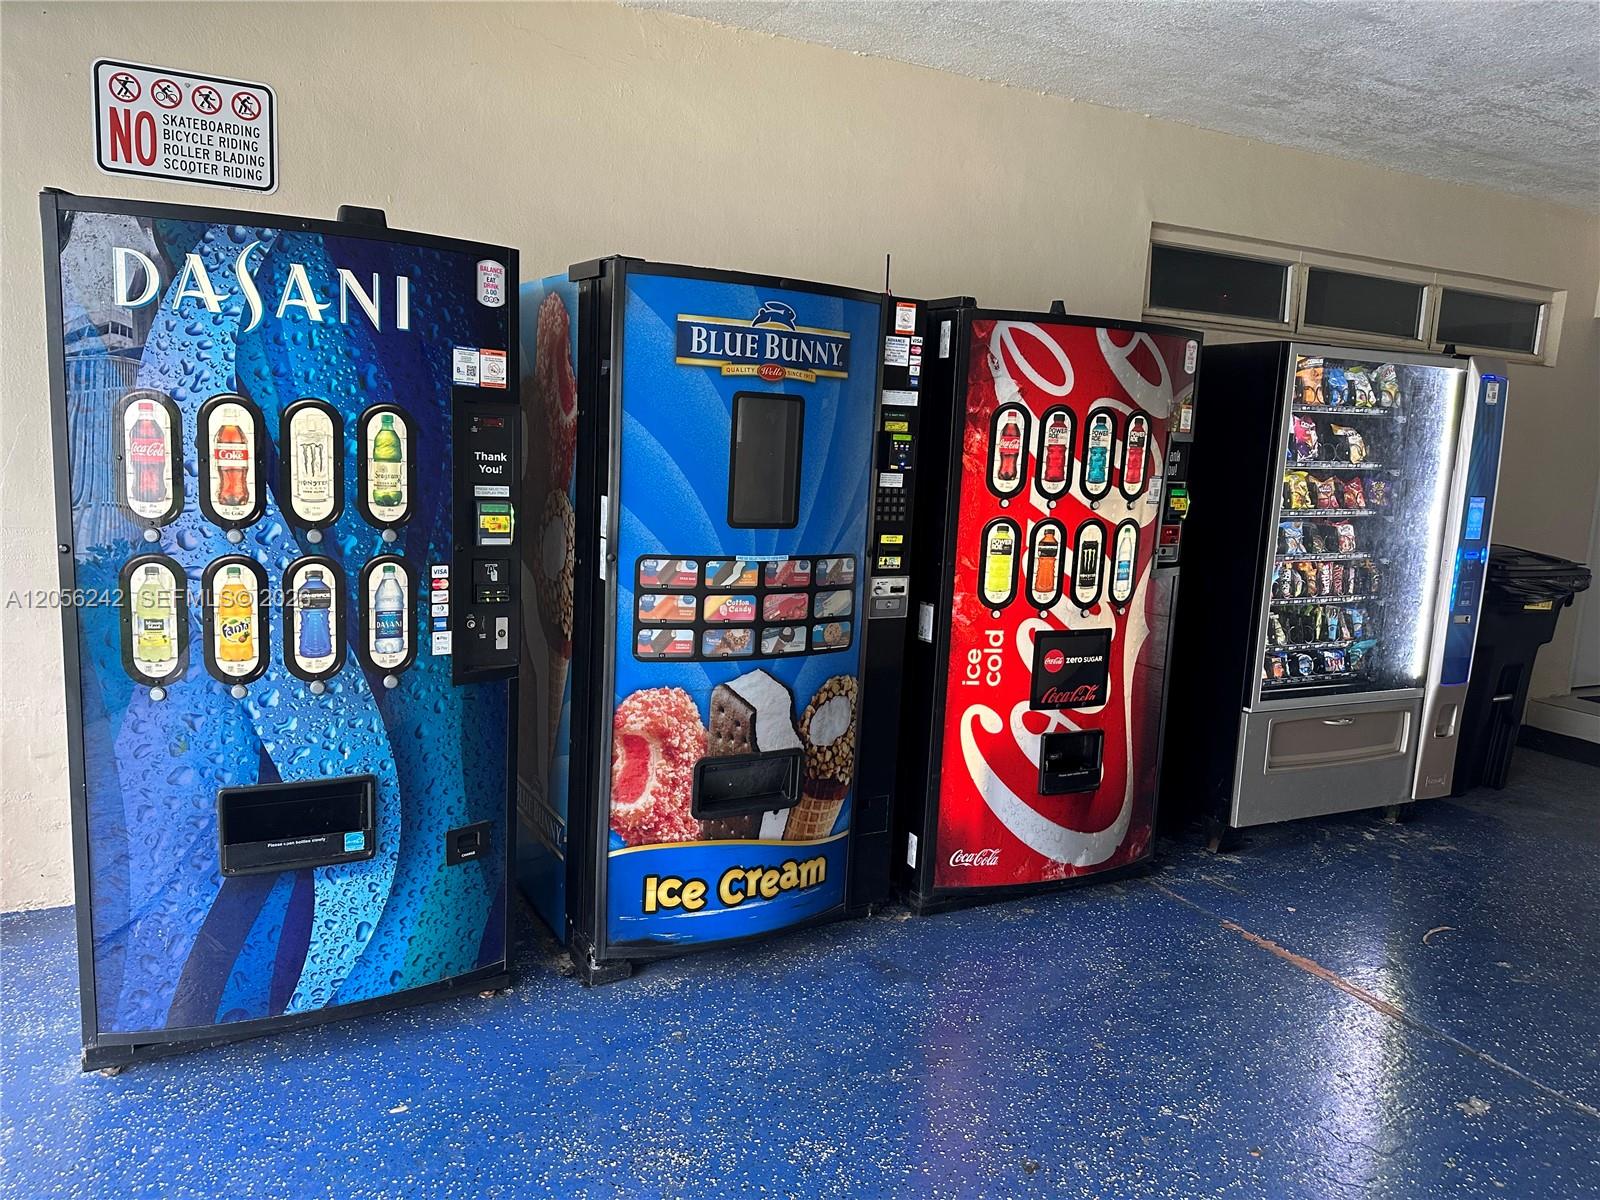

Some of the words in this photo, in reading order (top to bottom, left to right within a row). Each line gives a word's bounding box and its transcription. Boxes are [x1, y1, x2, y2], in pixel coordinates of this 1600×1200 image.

[162, 113, 260, 139] SKATEBOARDING
[109, 106, 157, 166] NO
[163, 129, 214, 146] BICYCLE
[219, 137, 258, 153] RIDING
[163, 143, 210, 160] ROLLER
[215, 150, 265, 167] BLADING
[163, 158, 218, 175] SCOOTER
[223, 165, 262, 181] RIDING
[479, 265, 503, 274] BALANCE
[112, 239, 410, 333] DASANI
[483, 282, 499, 290] DRINK
[690, 326, 759, 358] BLUE
[764, 332, 843, 367] BUNNY
[726, 366, 755, 374] QUALITY
[760, 366, 783, 378] Wells
[131, 441, 164, 457] Coca-Cola
[219, 449, 244, 460] Coke
[474, 451, 507, 462] Thank
[1169, 450, 1181, 462] ank
[479, 464, 503, 474] You!
[1167, 464, 1178, 476] ou!
[725, 599, 750, 607] Cotton
[728, 605, 752, 615] Candy
[376, 620, 402, 629] DASANI
[984, 630, 1004, 687] cold
[1065, 656, 1083, 664] zero
[1083, 655, 1103, 663] SUGAR
[962, 648, 982, 686] ice
[949, 848, 1002, 867] Coca-Cola
[643, 876, 707, 914] Ice
[718, 855, 827, 906] Cream
